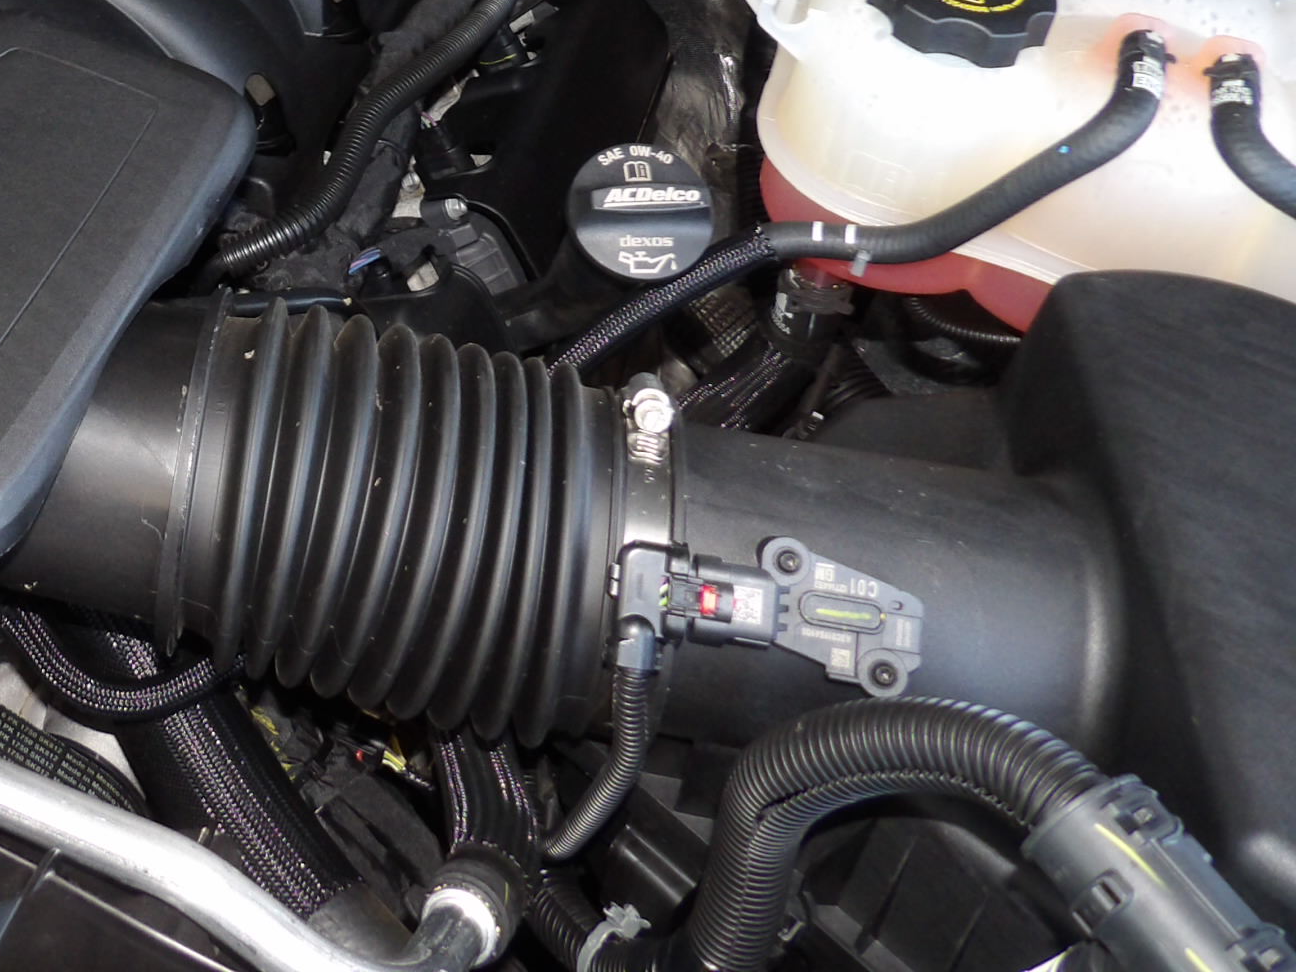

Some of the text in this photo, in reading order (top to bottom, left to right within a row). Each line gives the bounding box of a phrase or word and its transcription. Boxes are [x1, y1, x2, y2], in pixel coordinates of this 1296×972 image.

[597, 145, 674, 166] SAE 0W-40
[604, 187, 701, 202] ACDelco
[619, 235, 674, 247] dexos
